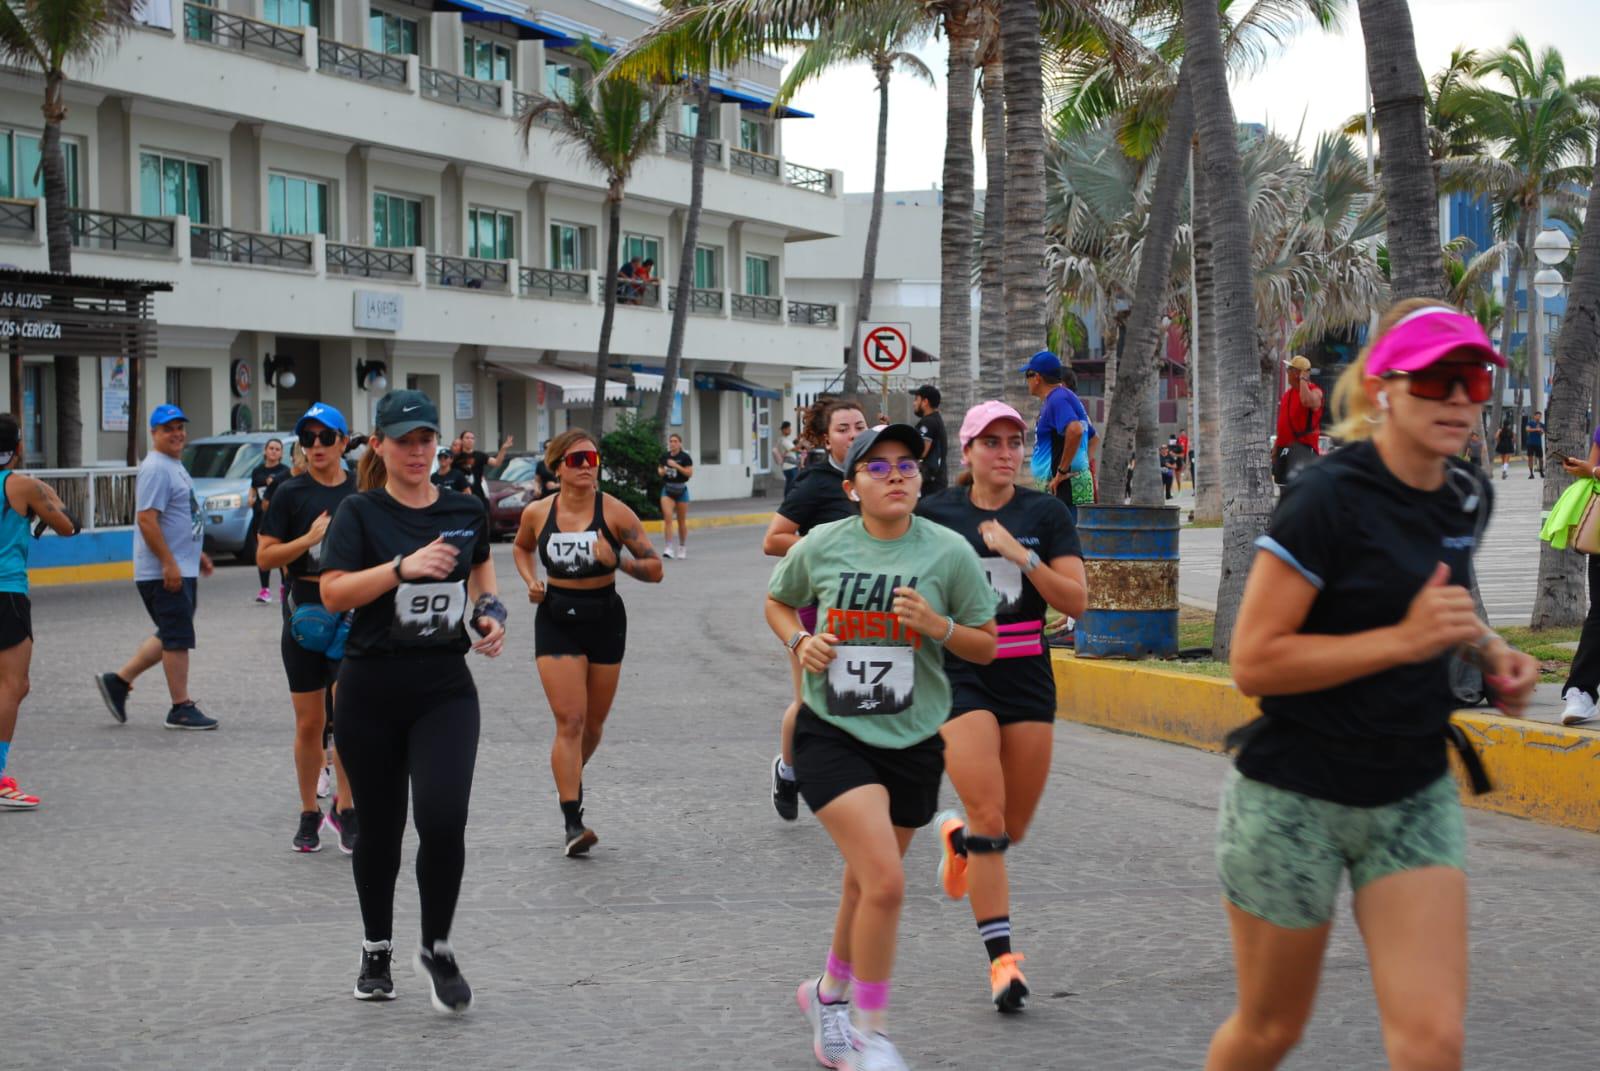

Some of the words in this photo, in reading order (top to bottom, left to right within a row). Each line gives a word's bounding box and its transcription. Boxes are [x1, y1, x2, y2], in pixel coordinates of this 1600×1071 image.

[15, 293, 43, 309] ALTAS
[21, 322, 61, 339] CERVEZA
[875, 335, 896, 363] E
[552, 541, 590, 557] 174
[410, 594, 450, 614] 90
[846, 660, 893, 685] 47
